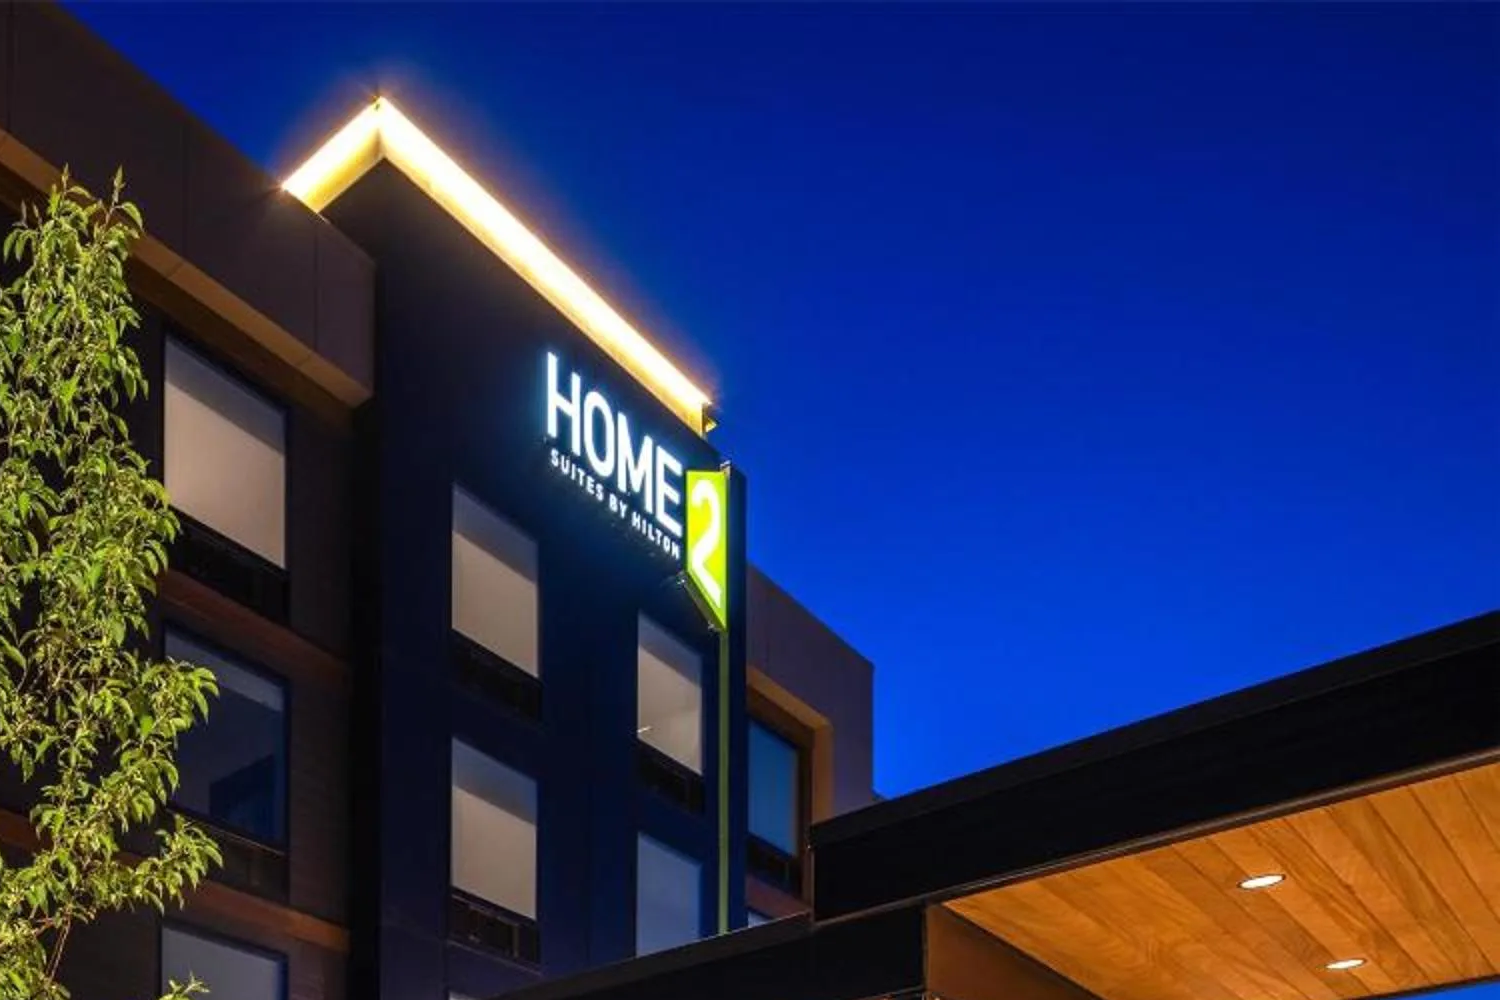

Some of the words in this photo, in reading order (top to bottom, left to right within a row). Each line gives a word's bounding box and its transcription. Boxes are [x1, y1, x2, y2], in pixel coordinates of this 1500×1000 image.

[547, 351, 683, 538] HOME
[690, 477, 722, 609] 2
[551, 448, 604, 501] SUITES
[609, 493, 628, 518] BY
[631, 511, 680, 560] HILTON
